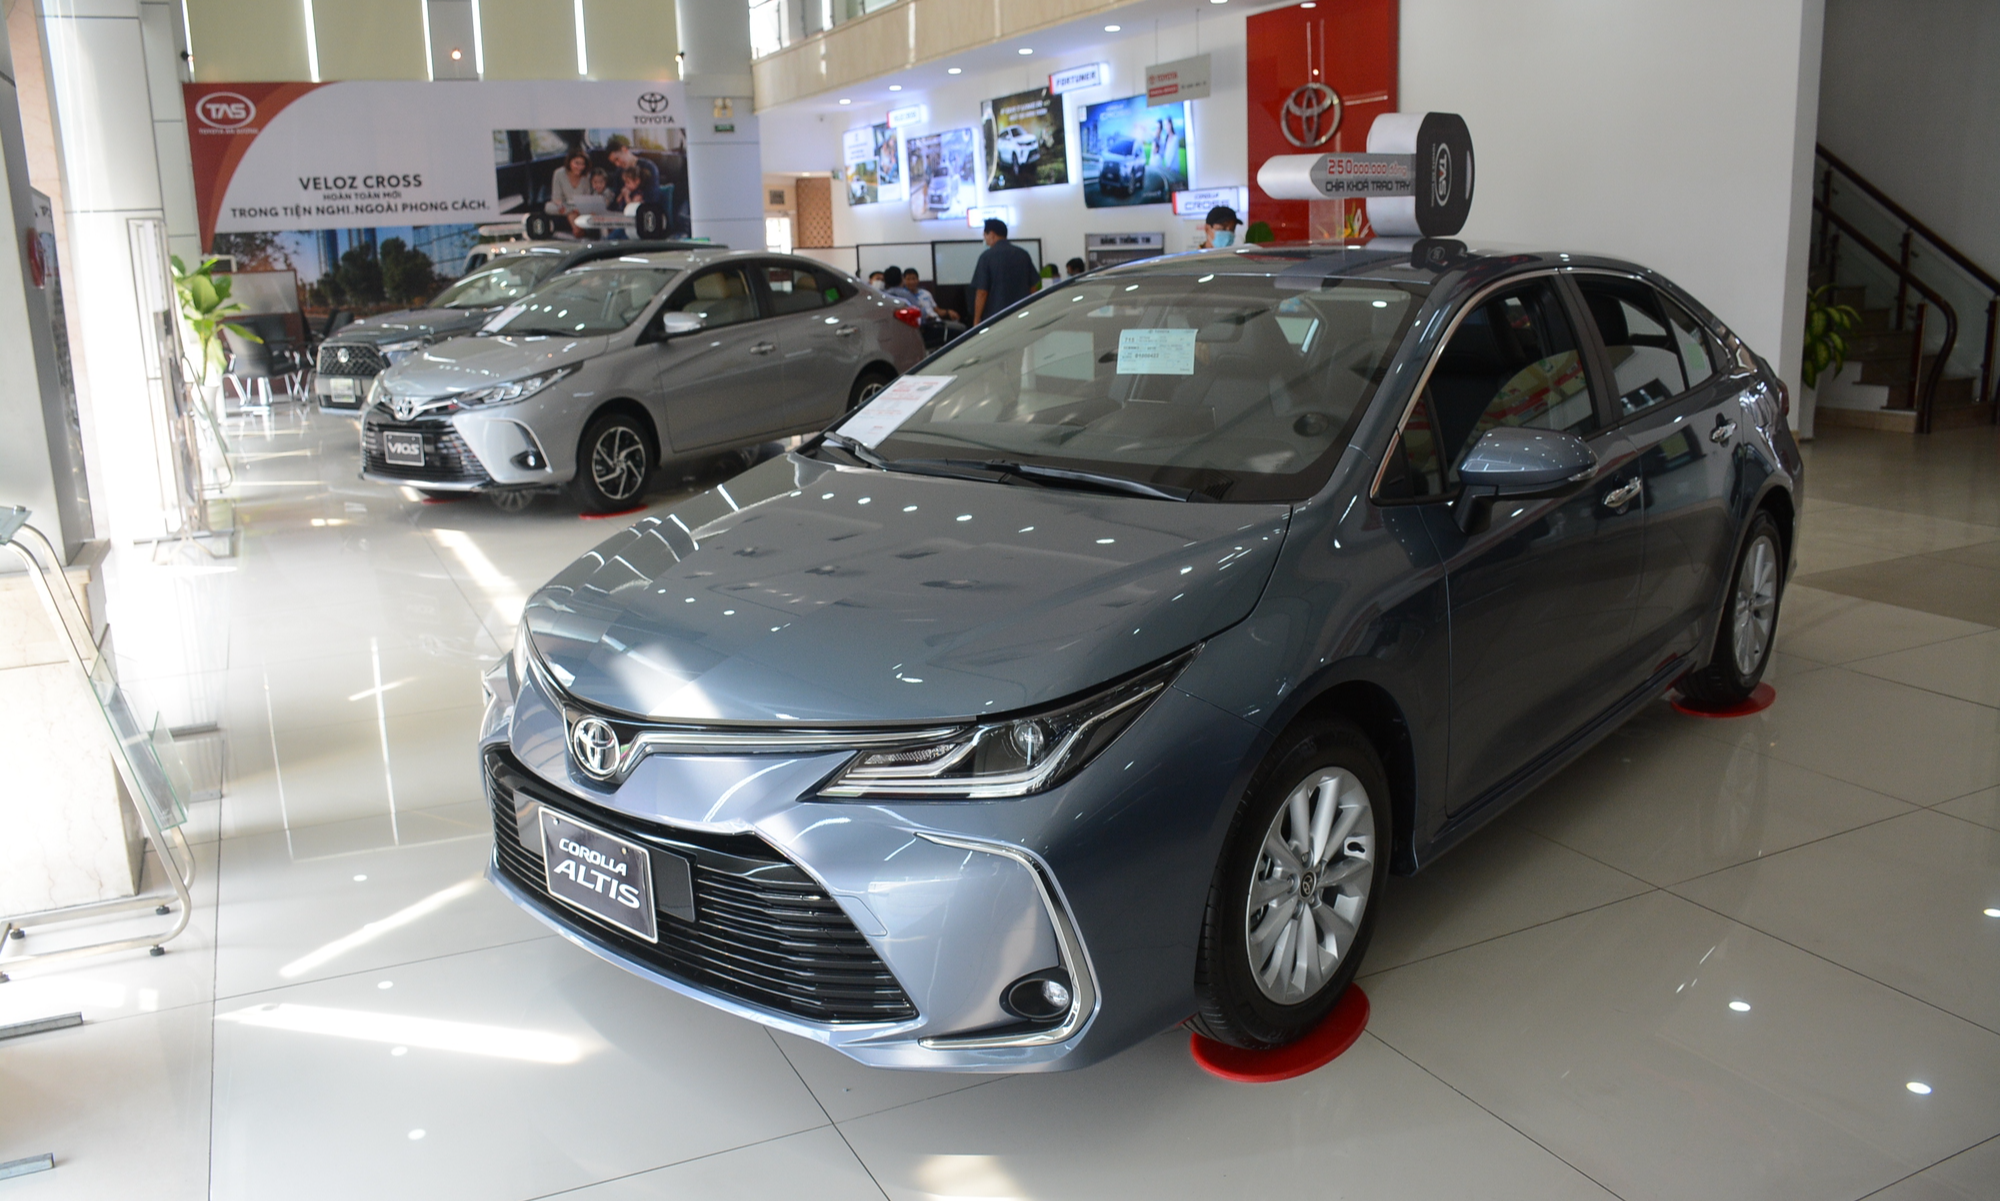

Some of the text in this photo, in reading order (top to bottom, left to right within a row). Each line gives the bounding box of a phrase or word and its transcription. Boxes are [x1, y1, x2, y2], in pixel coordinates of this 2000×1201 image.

[206, 104, 247, 119] TAS
[633, 115, 676, 125] TOYOTA
[299, 174, 423, 190] VELOZ CROSS
[1438, 153, 1448, 196] TAS
[1371, 180, 1394, 192] TRAO
[1395, 180, 1411, 191] TAY
[231, 207, 280, 219] TRONG
[282, 204, 313, 220] TIỆN
[401, 201, 450, 213] PHONG
[387, 442, 420, 455] VIOS
[558, 838, 627, 877] COROLLA
[553, 859, 641, 909] ALTIS
